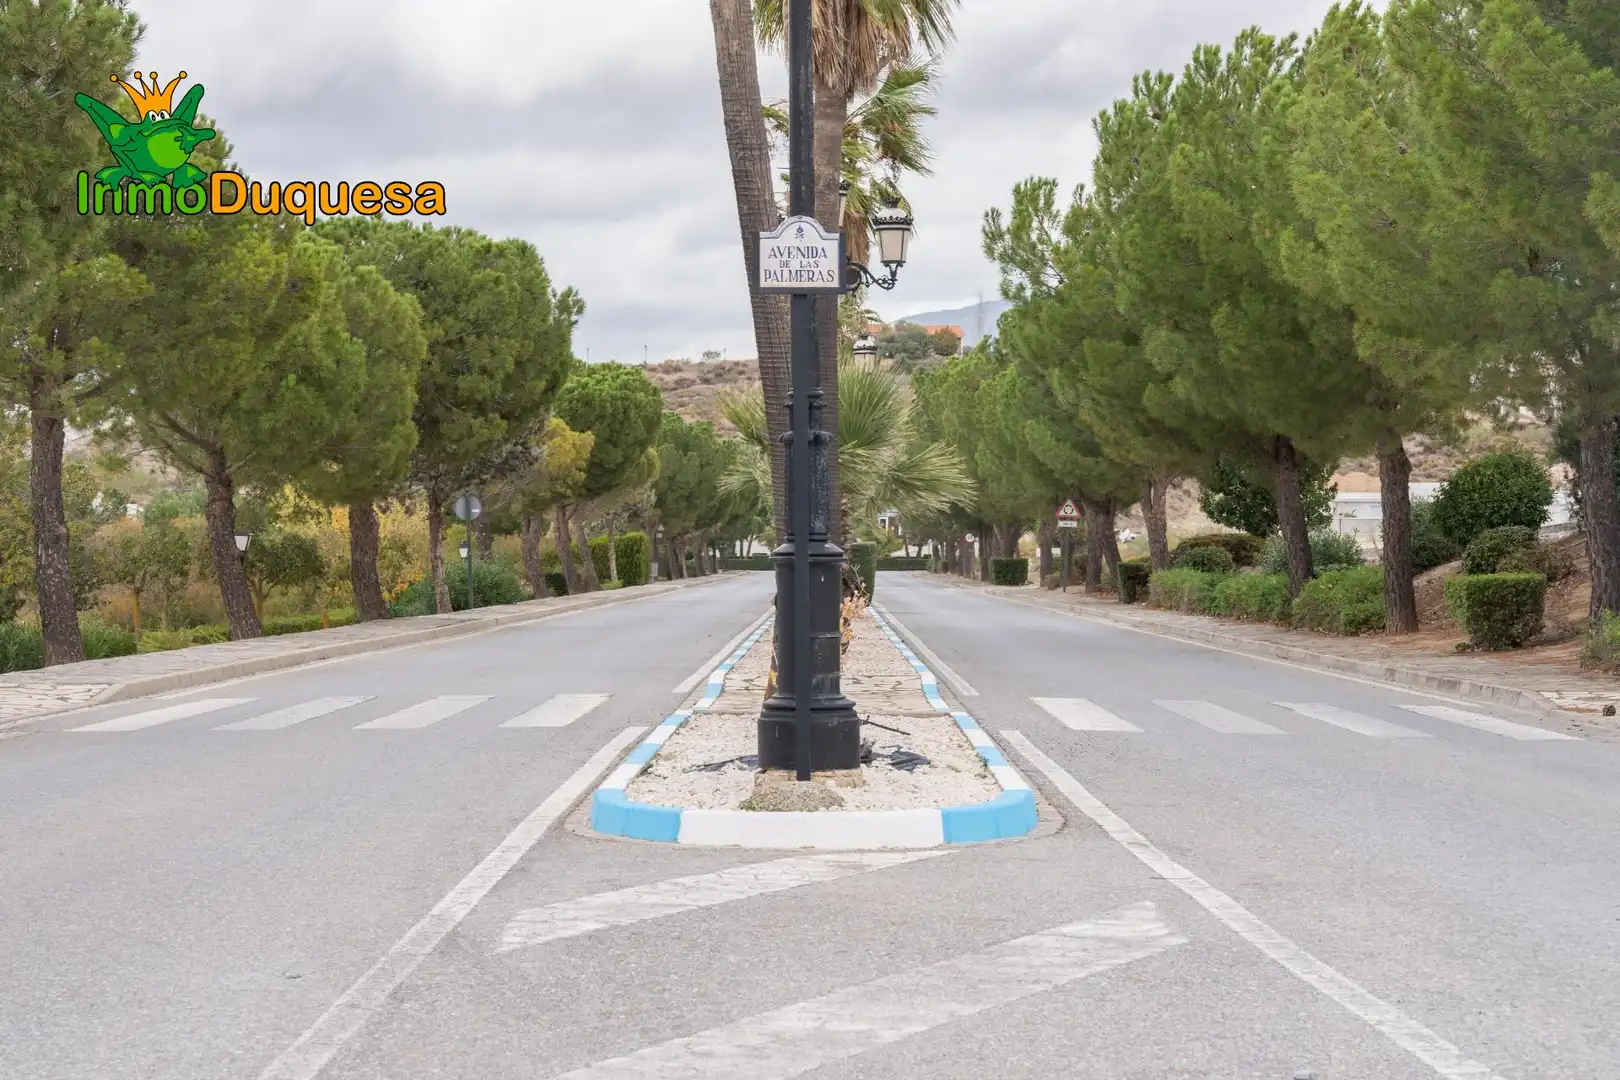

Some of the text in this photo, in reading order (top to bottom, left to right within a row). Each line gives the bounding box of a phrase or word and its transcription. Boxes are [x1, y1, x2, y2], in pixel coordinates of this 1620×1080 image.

[768, 246, 828, 259] AVENIDA
[779, 260, 819, 268] DE LAS
[764, 269, 835, 282] PALMERAS
